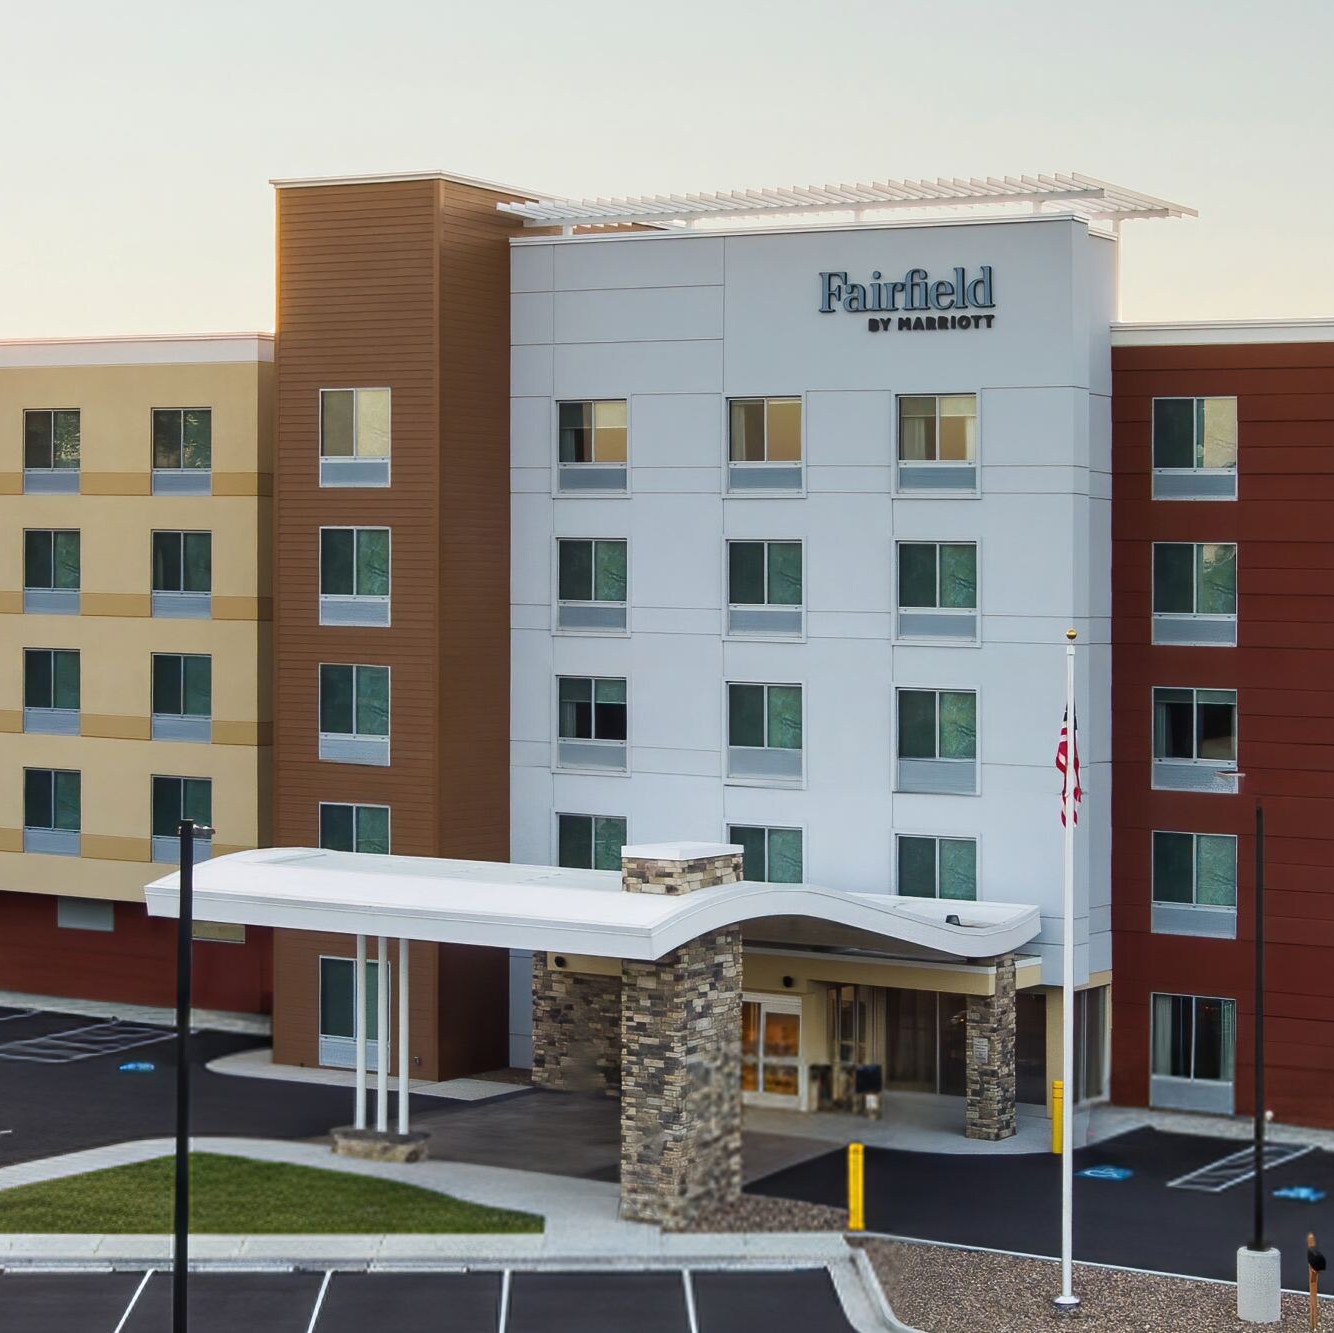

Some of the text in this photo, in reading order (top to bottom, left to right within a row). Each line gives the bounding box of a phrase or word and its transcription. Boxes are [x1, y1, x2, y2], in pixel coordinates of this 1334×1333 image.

[819, 266, 996, 313] Fairfield
[868, 315, 995, 332] BY MARRIOTT
